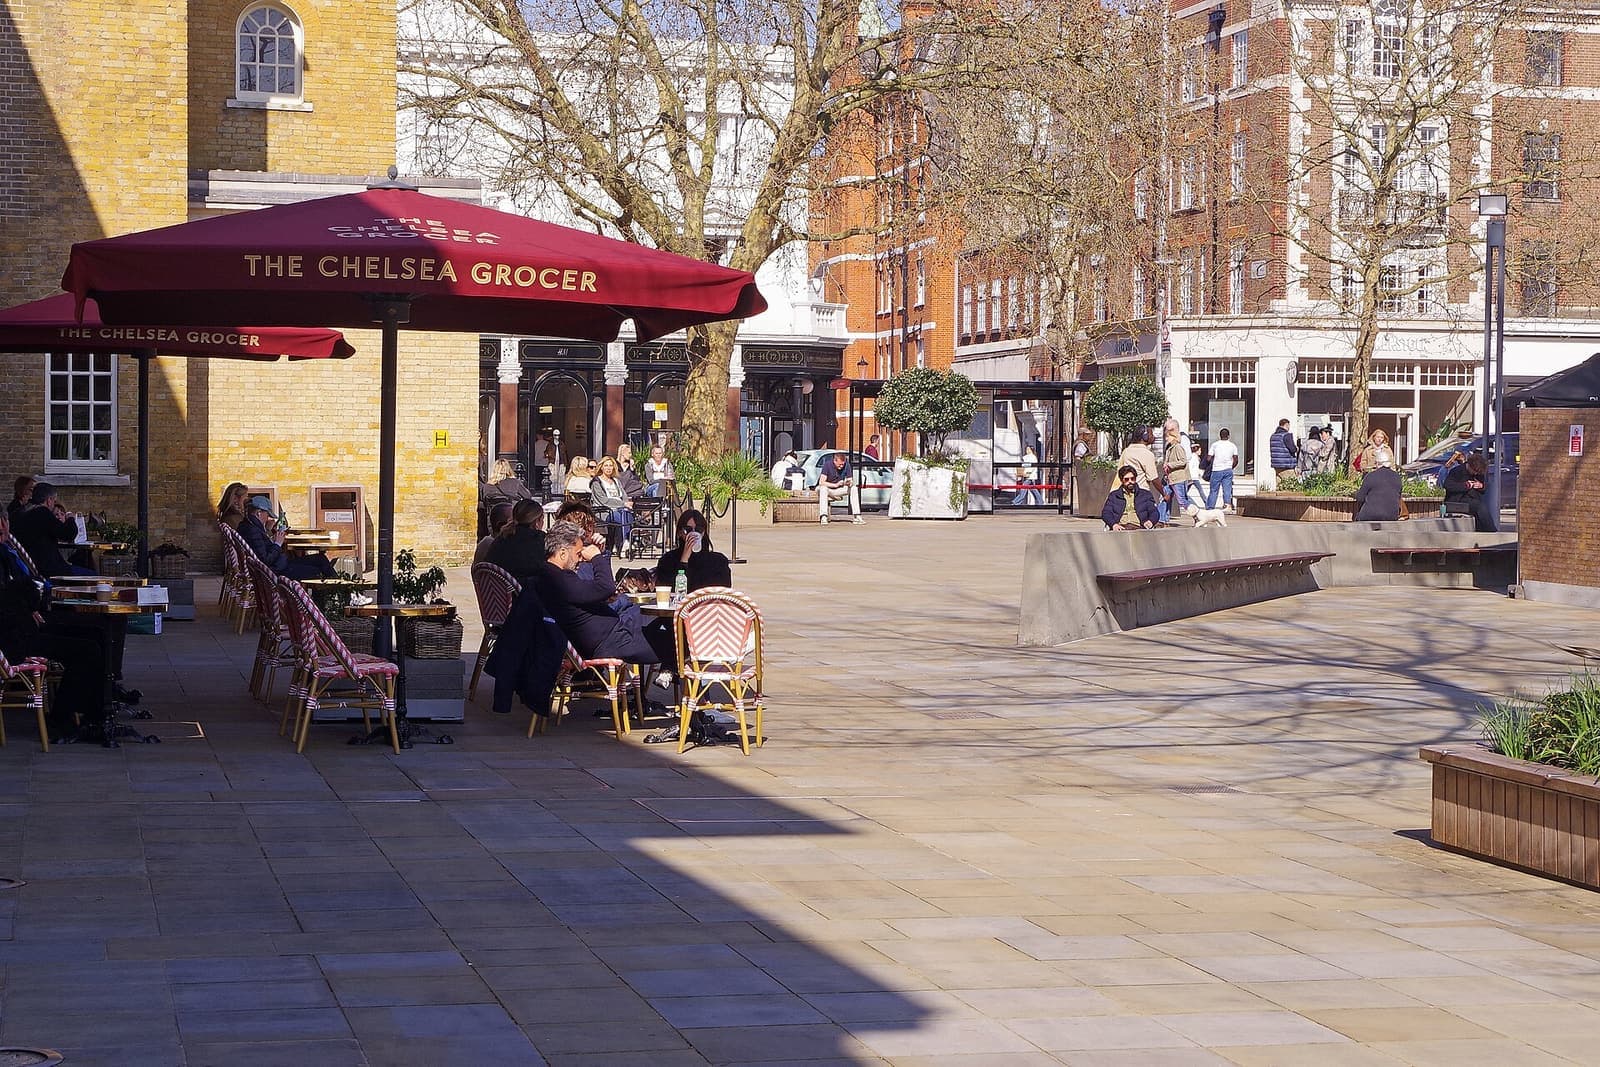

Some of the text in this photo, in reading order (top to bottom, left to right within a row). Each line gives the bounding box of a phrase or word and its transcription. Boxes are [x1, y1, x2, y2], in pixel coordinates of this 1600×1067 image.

[374, 218, 445, 227] THE
[327, 225, 501, 239] CHELSEA
[336, 232, 499, 245] GROCER
[244, 254, 598, 293] THE CHELSEA GROCER
[58, 328, 260, 347] THE CHELSEA GROCER
[435, 432, 447, 446] H
